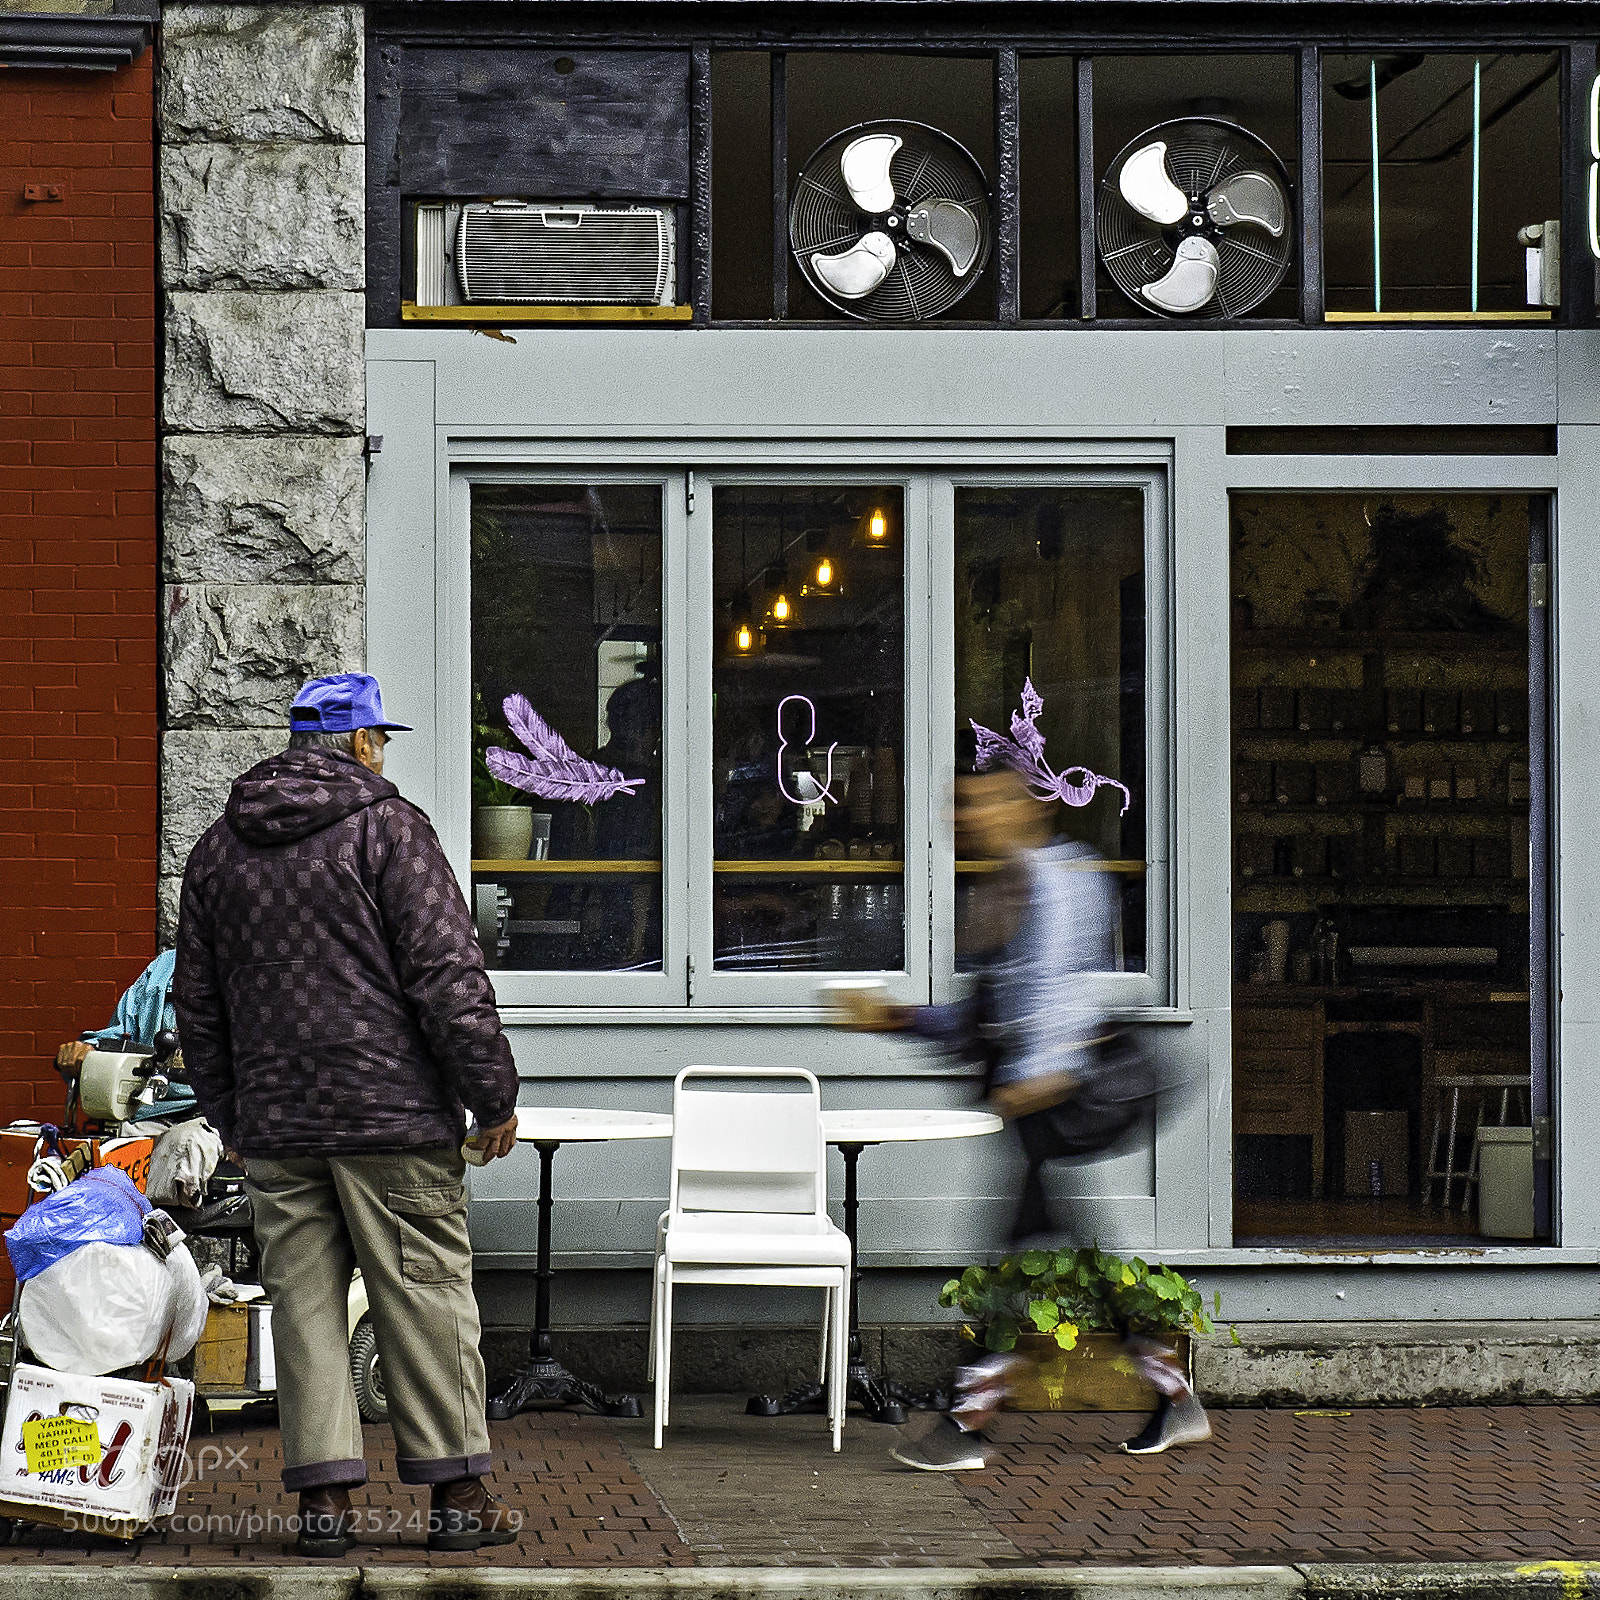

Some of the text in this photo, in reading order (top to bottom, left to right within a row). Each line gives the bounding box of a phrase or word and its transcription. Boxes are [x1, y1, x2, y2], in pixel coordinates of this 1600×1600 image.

[777, 694, 838, 805] &
[40, 1418, 73, 1429] YAMS
[38, 1427, 81, 1440] GARNET
[35, 1434, 96, 1450] MED CALIF
